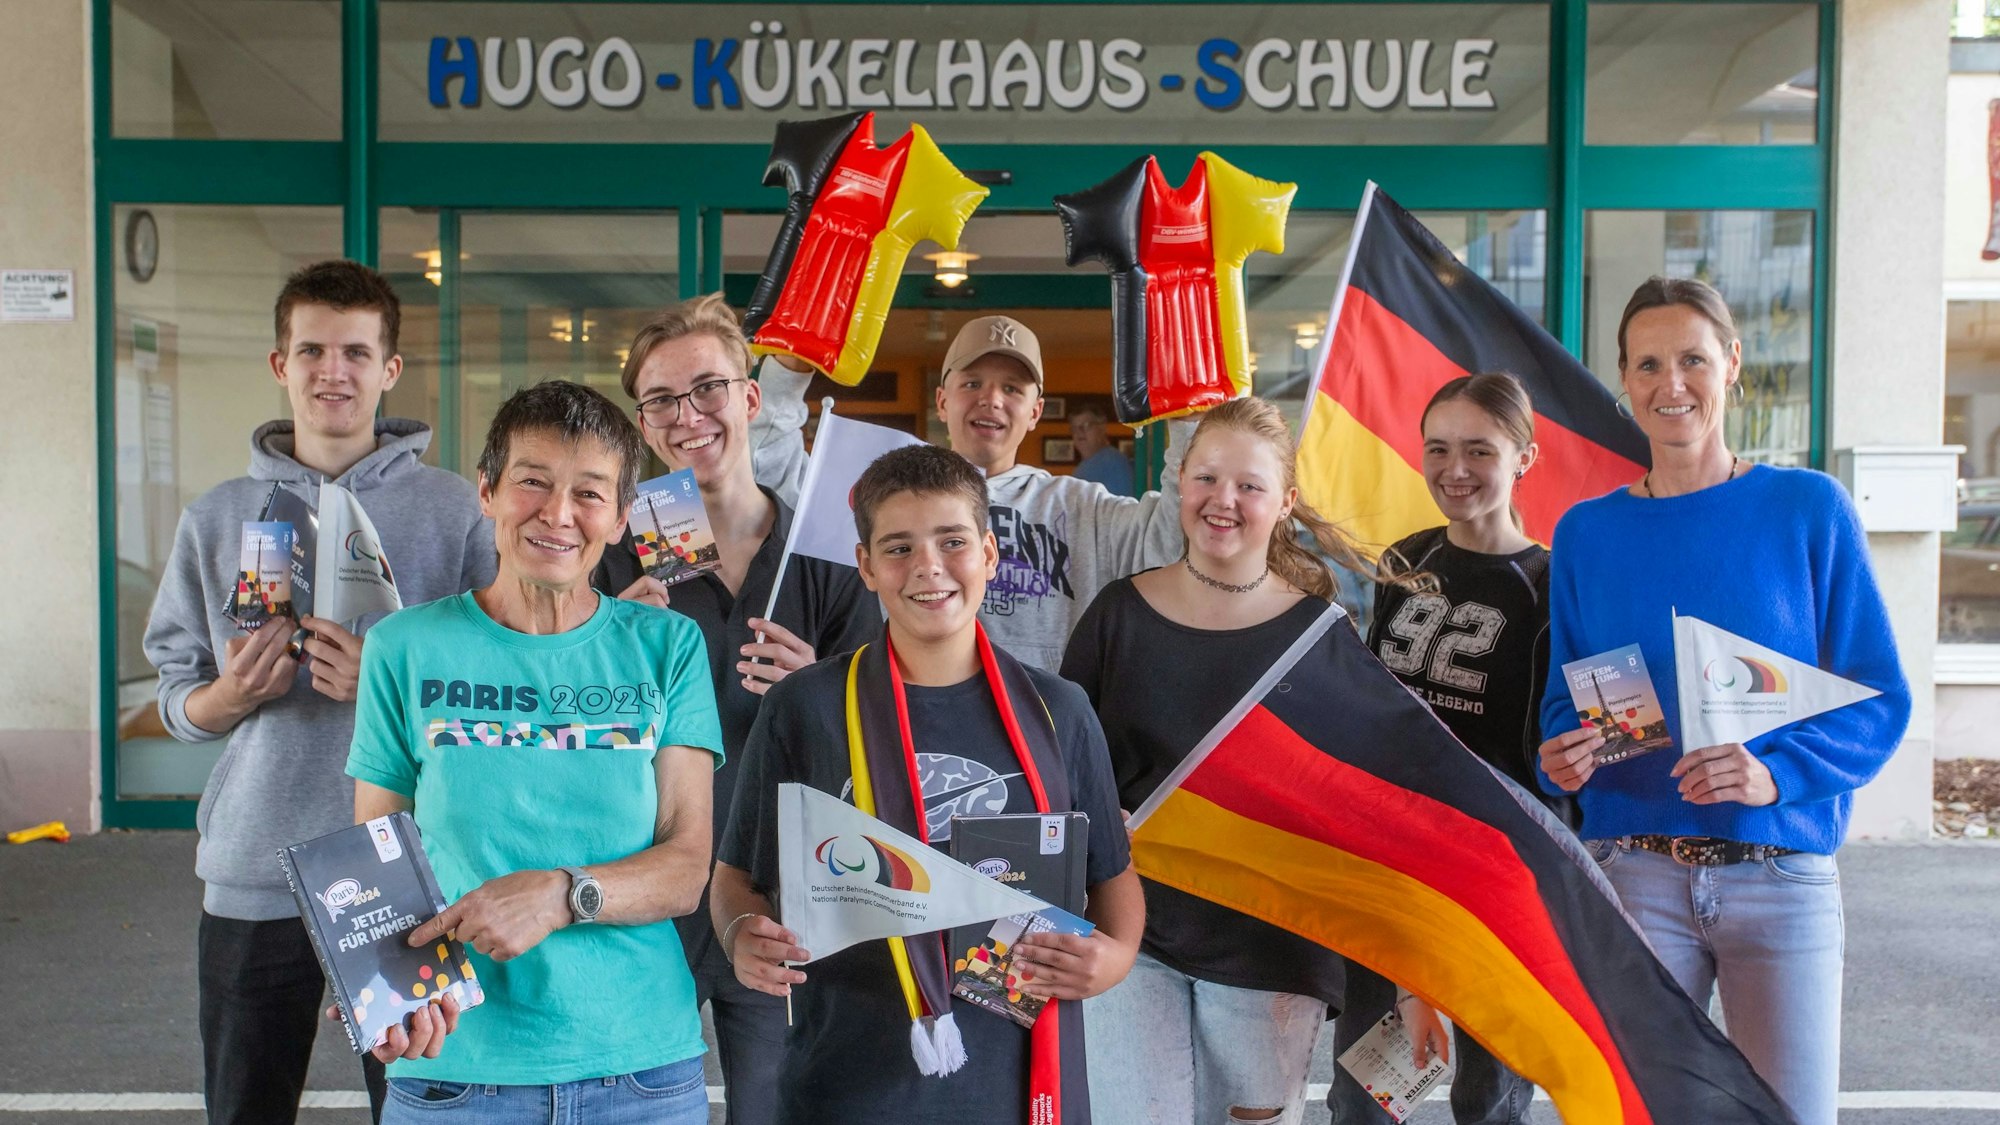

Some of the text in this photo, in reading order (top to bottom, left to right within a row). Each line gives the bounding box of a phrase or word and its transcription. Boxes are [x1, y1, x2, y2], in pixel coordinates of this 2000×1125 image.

[631, 495, 676, 515] LEISTUNG
[291, 543, 305, 558] 024
[290, 571, 311, 594] MER.
[1379, 592, 1508, 694] 92
[1572, 665, 1615, 684] SPITZEN-
[1575, 671, 1621, 691] LEISTUNG
[420, 679, 663, 716] PARIS 2024
[1427, 690, 1485, 715] LEGEND
[329, 884, 356, 904] Paris
[353, 886, 381, 906] 2024
[811, 884, 845, 893] Deutscher
[350, 904, 399, 931] JETZT.
[811, 895, 839, 903] National
[839, 895, 873, 907] Paralympic
[895, 910, 927, 923] Germany
[1007, 914, 1051, 933] LEISTUN
[1023, 910, 1057, 931] ITZEN-
[337, 913, 422, 953] FÜR IMMER.
[1404, 1064, 1442, 1101] TV-ZEITEN
[1046, 1095, 1054, 1125] Logistics
